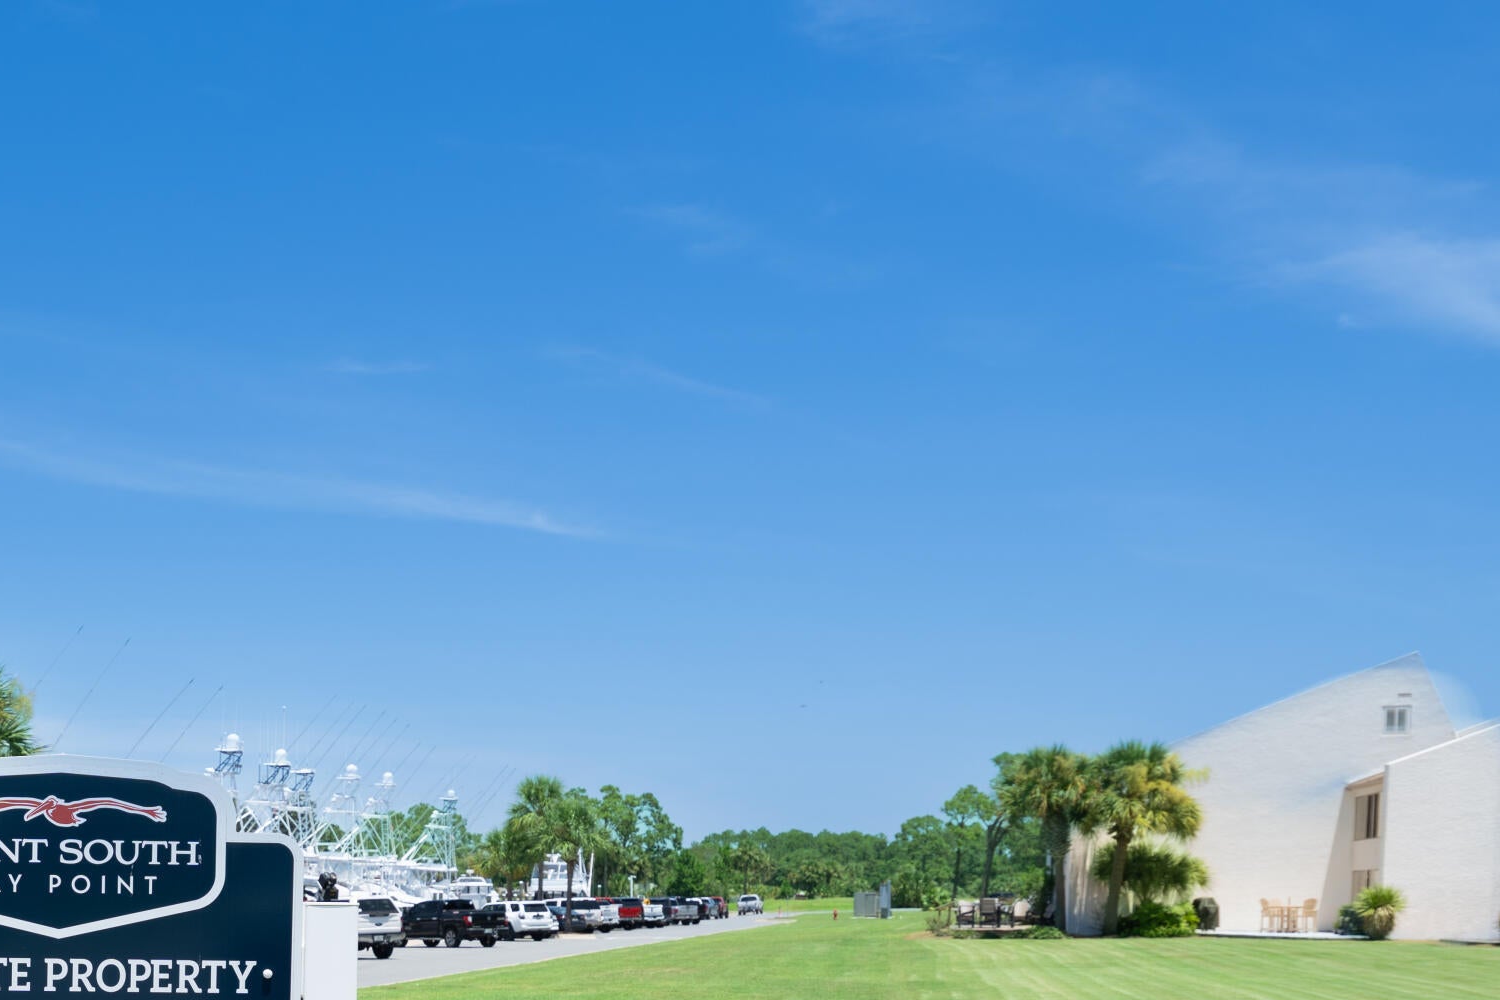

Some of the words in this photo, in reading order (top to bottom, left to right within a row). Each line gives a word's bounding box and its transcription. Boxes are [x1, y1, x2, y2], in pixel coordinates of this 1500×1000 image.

[60, 838, 199, 866] SOUTH
[50, 874, 158, 895] POINT
[44, 957, 257, 994] PROPERTY
